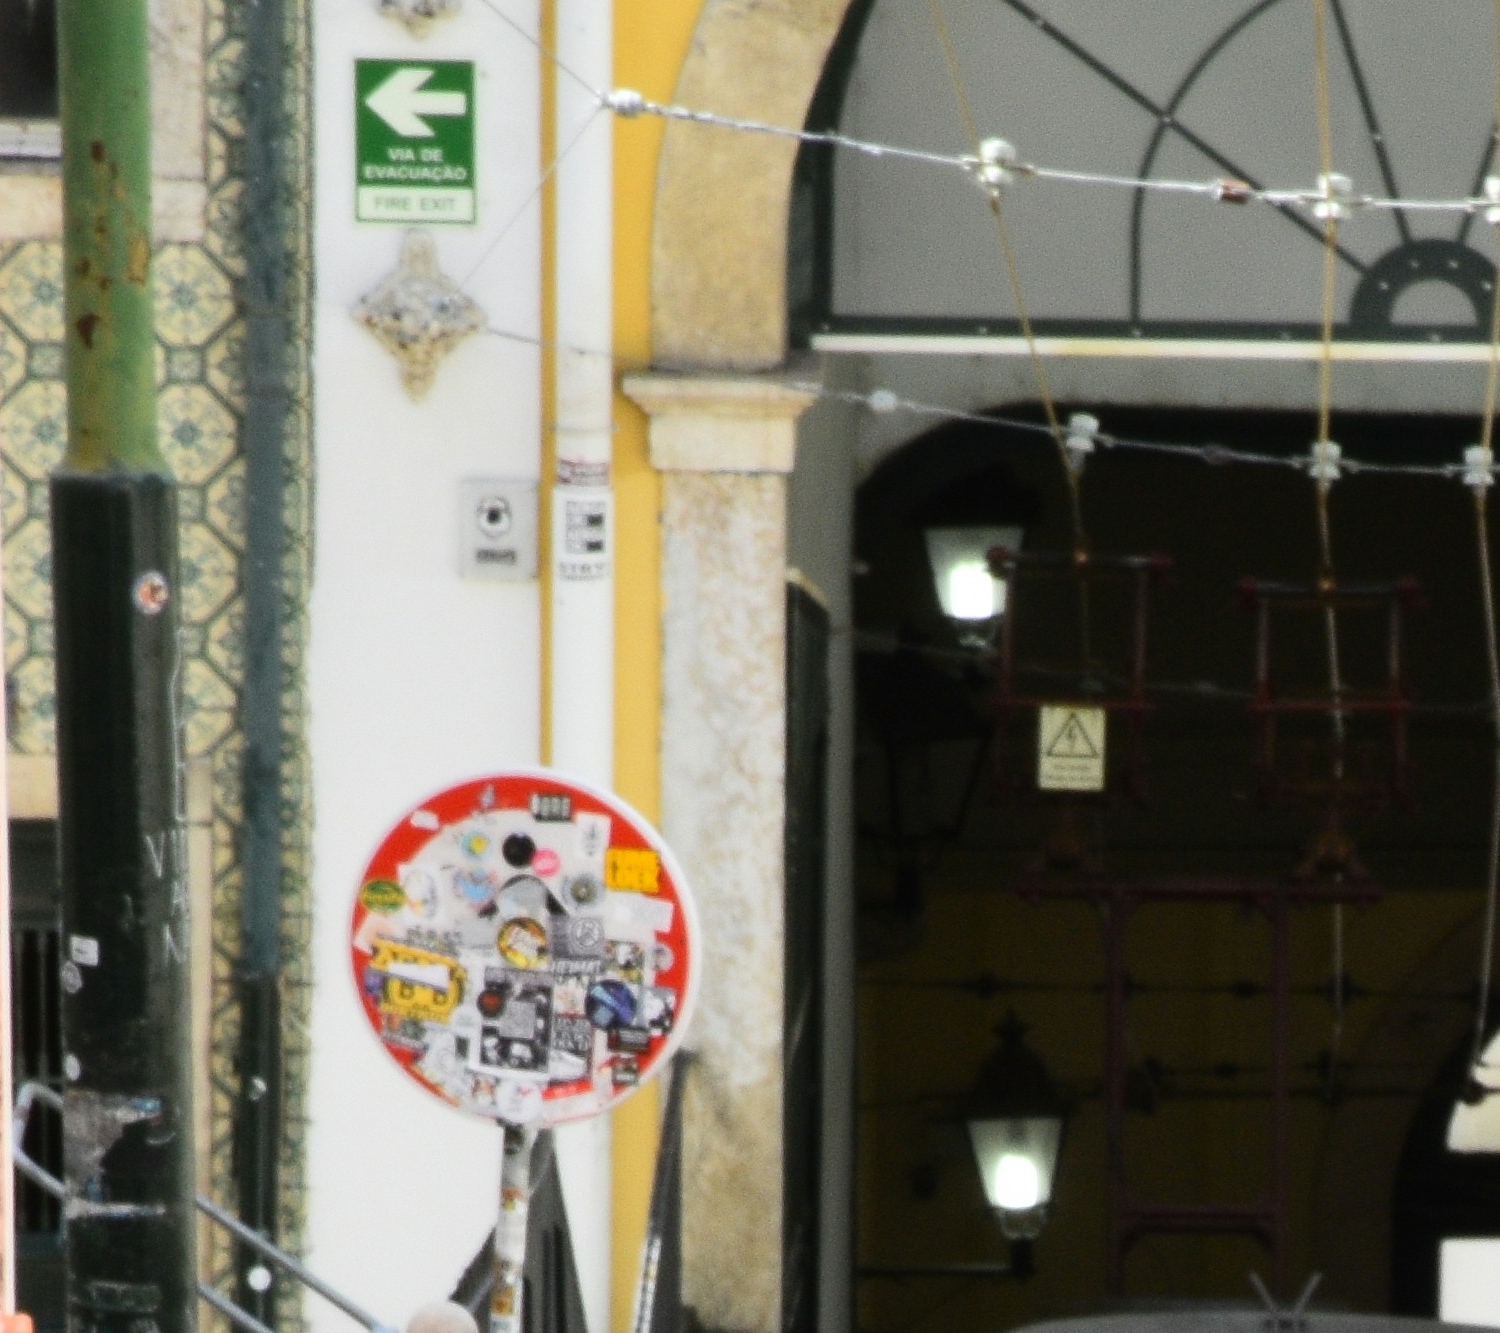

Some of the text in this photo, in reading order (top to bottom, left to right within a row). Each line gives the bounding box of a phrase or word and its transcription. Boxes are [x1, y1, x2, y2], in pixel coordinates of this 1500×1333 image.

[387, 148, 443, 162] VIA DE
[364, 165, 467, 181] EVACUAÇÃO
[374, 197, 455, 211] FIRE EXIT
